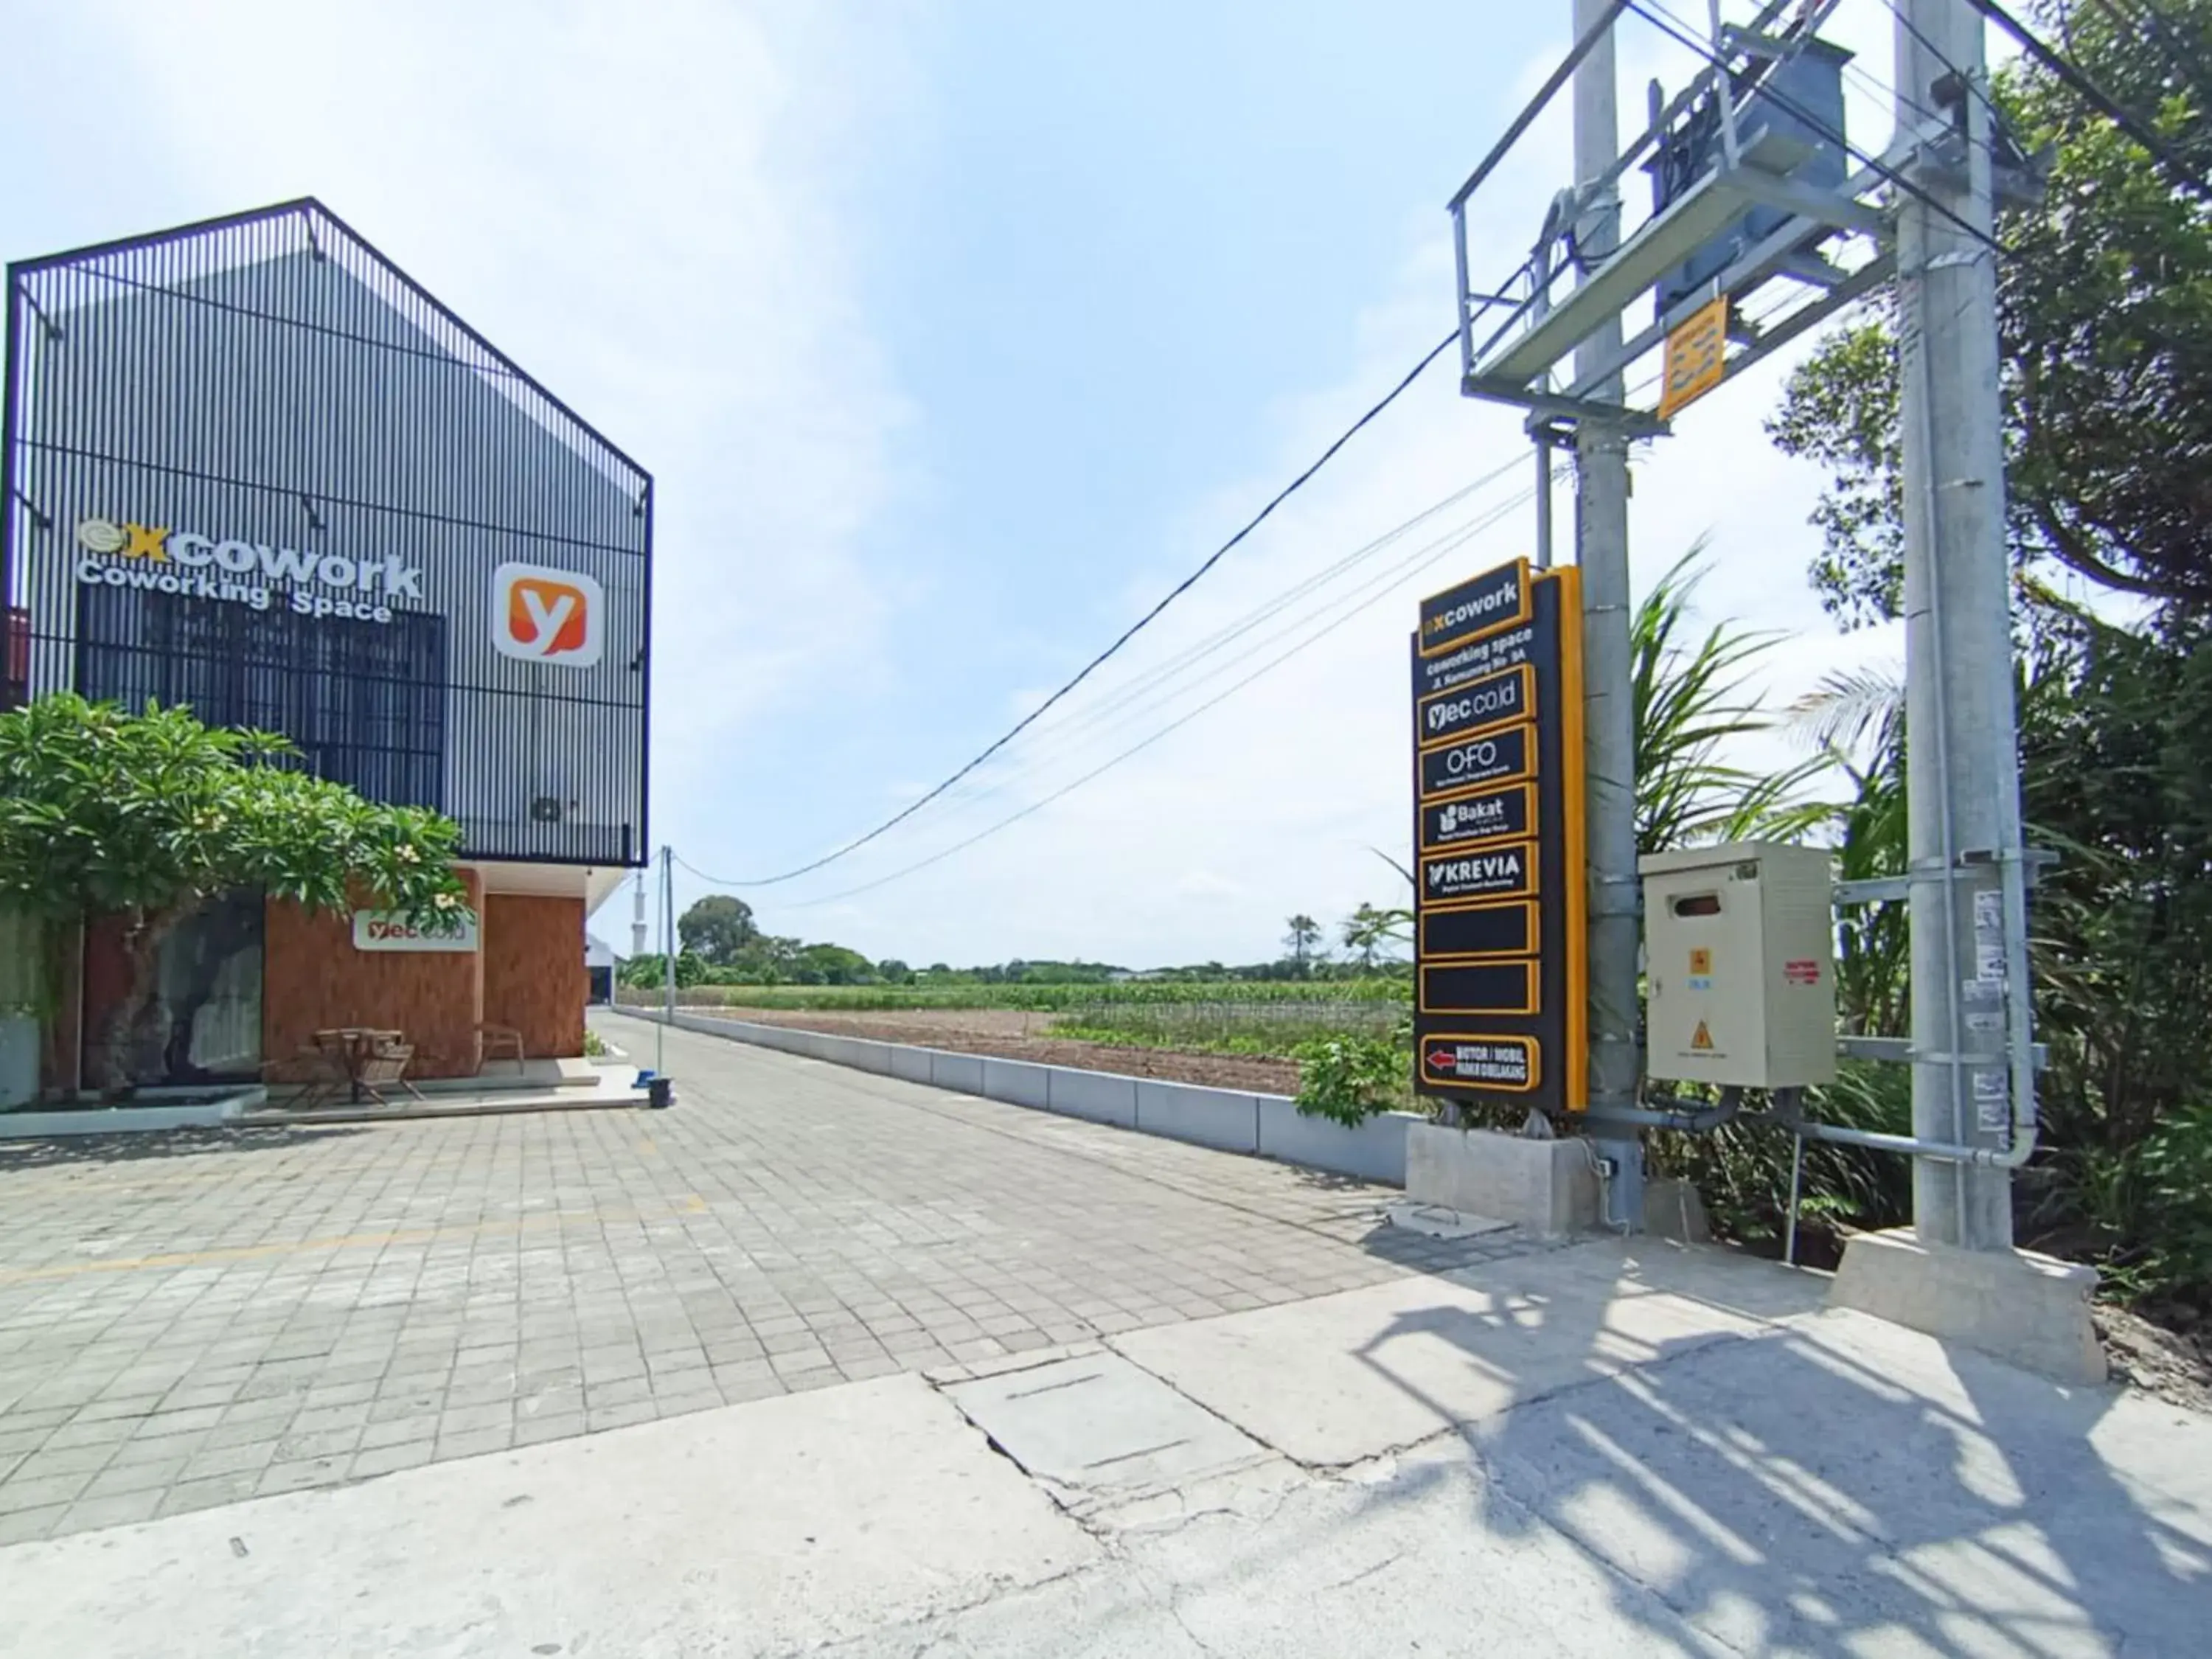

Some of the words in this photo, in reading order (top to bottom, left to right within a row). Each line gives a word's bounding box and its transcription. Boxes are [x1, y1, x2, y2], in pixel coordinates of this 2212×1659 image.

[76, 560, 271, 611] Coworking
[291, 590, 392, 624] Space
[1492, 627, 1532, 655] space
[1457, 797, 1503, 822] Bakat
[1445, 854, 1519, 883] KREVIA
